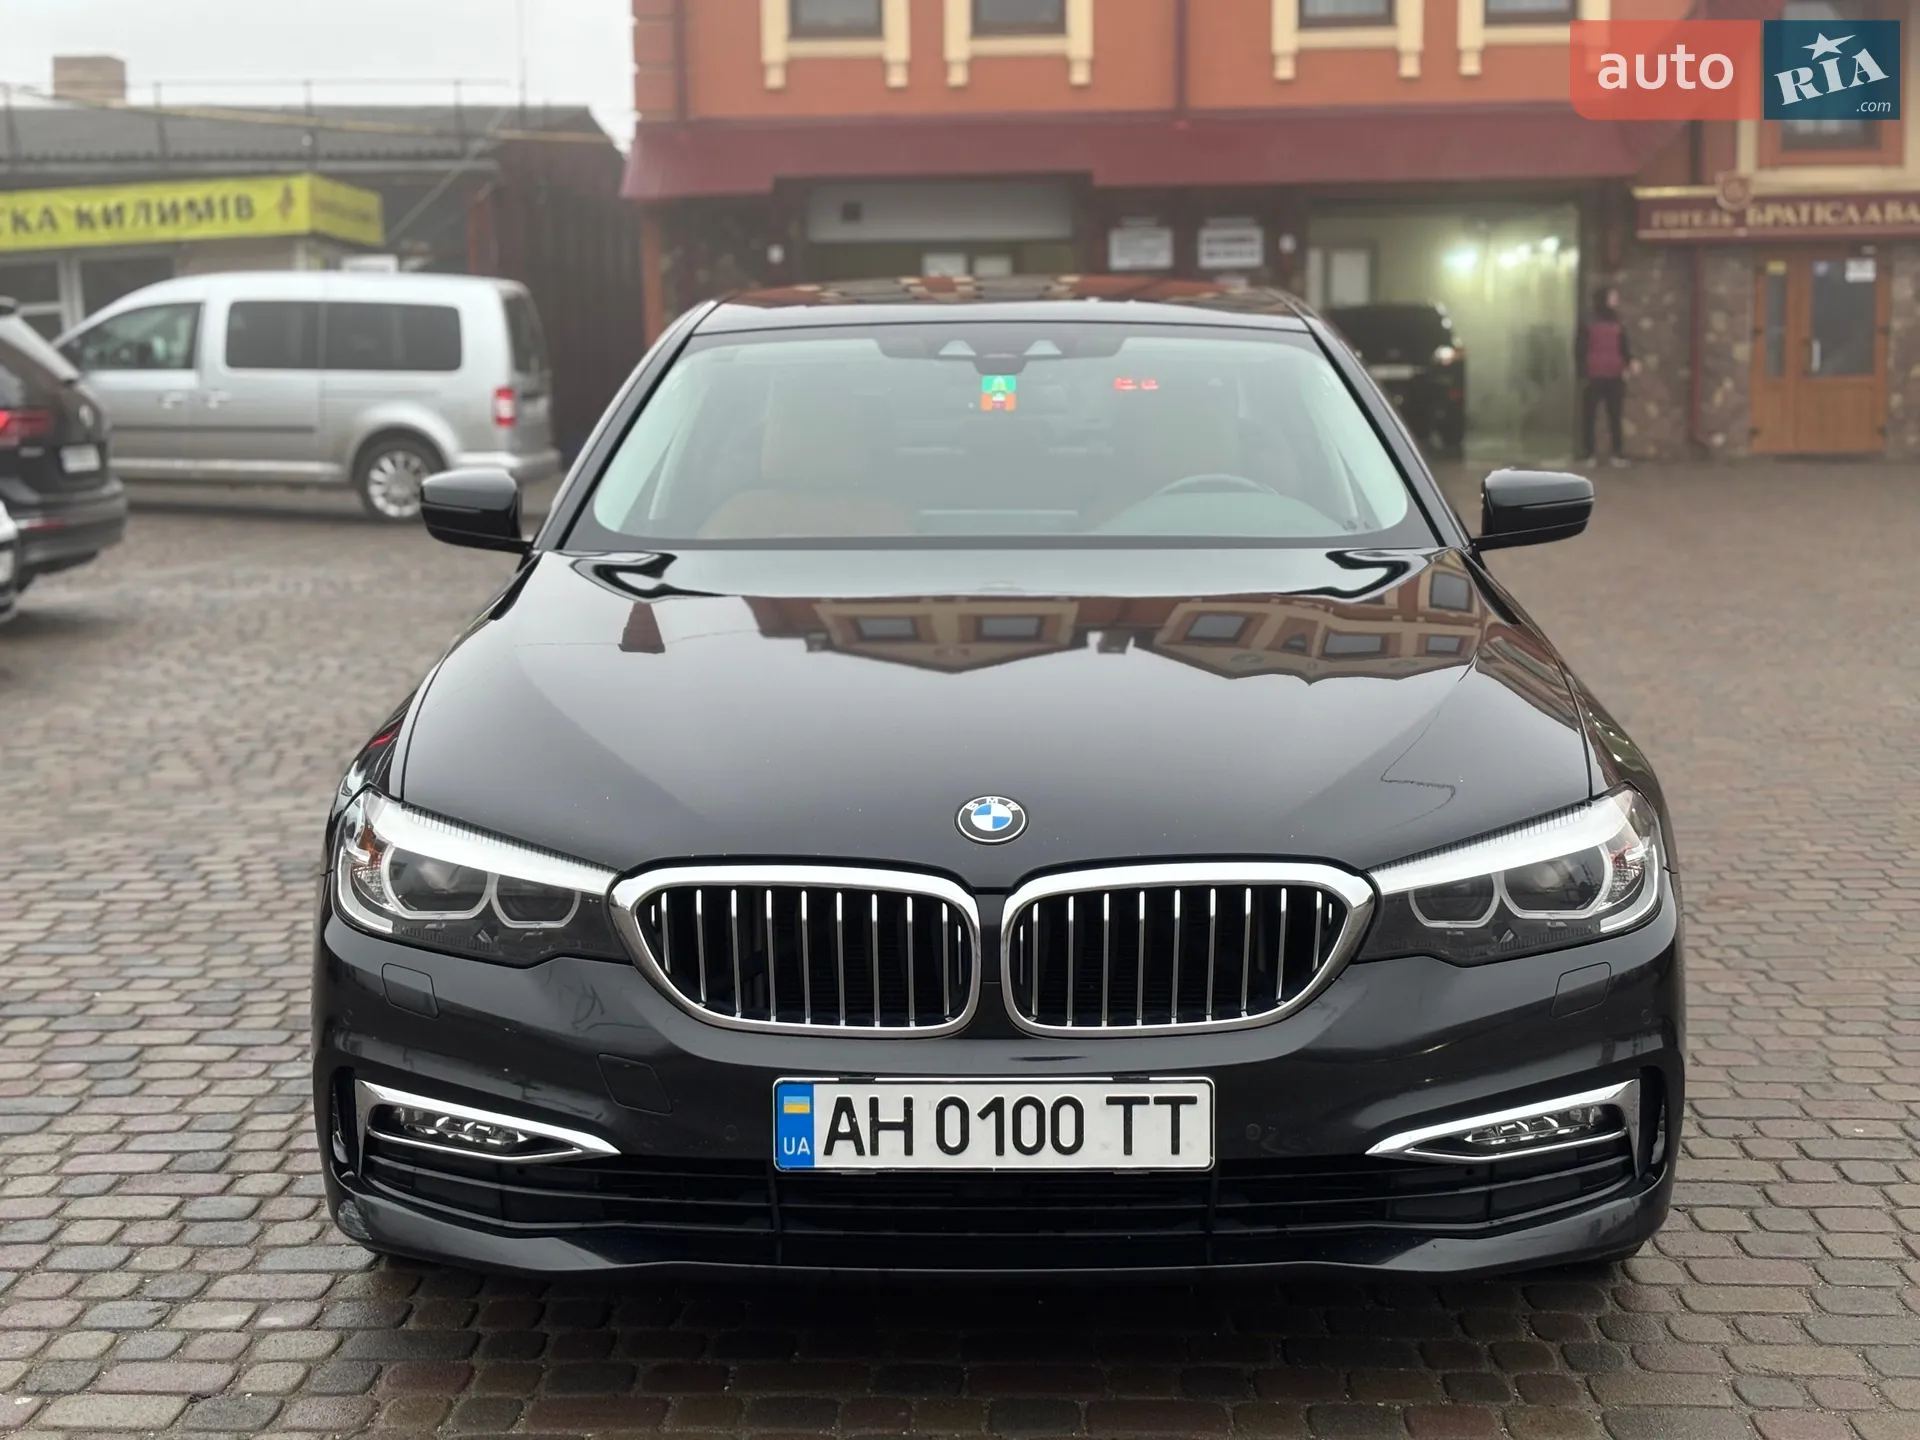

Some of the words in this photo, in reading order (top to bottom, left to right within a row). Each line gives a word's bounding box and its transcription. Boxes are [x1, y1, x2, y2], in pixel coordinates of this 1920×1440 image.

[964, 796, 1020, 811] BMW
[823, 1096, 914, 1156] AH
[935, 1095, 1085, 1156] 0100
[1106, 1095, 1198, 1156] TT
[783, 1137, 810, 1155] UA
